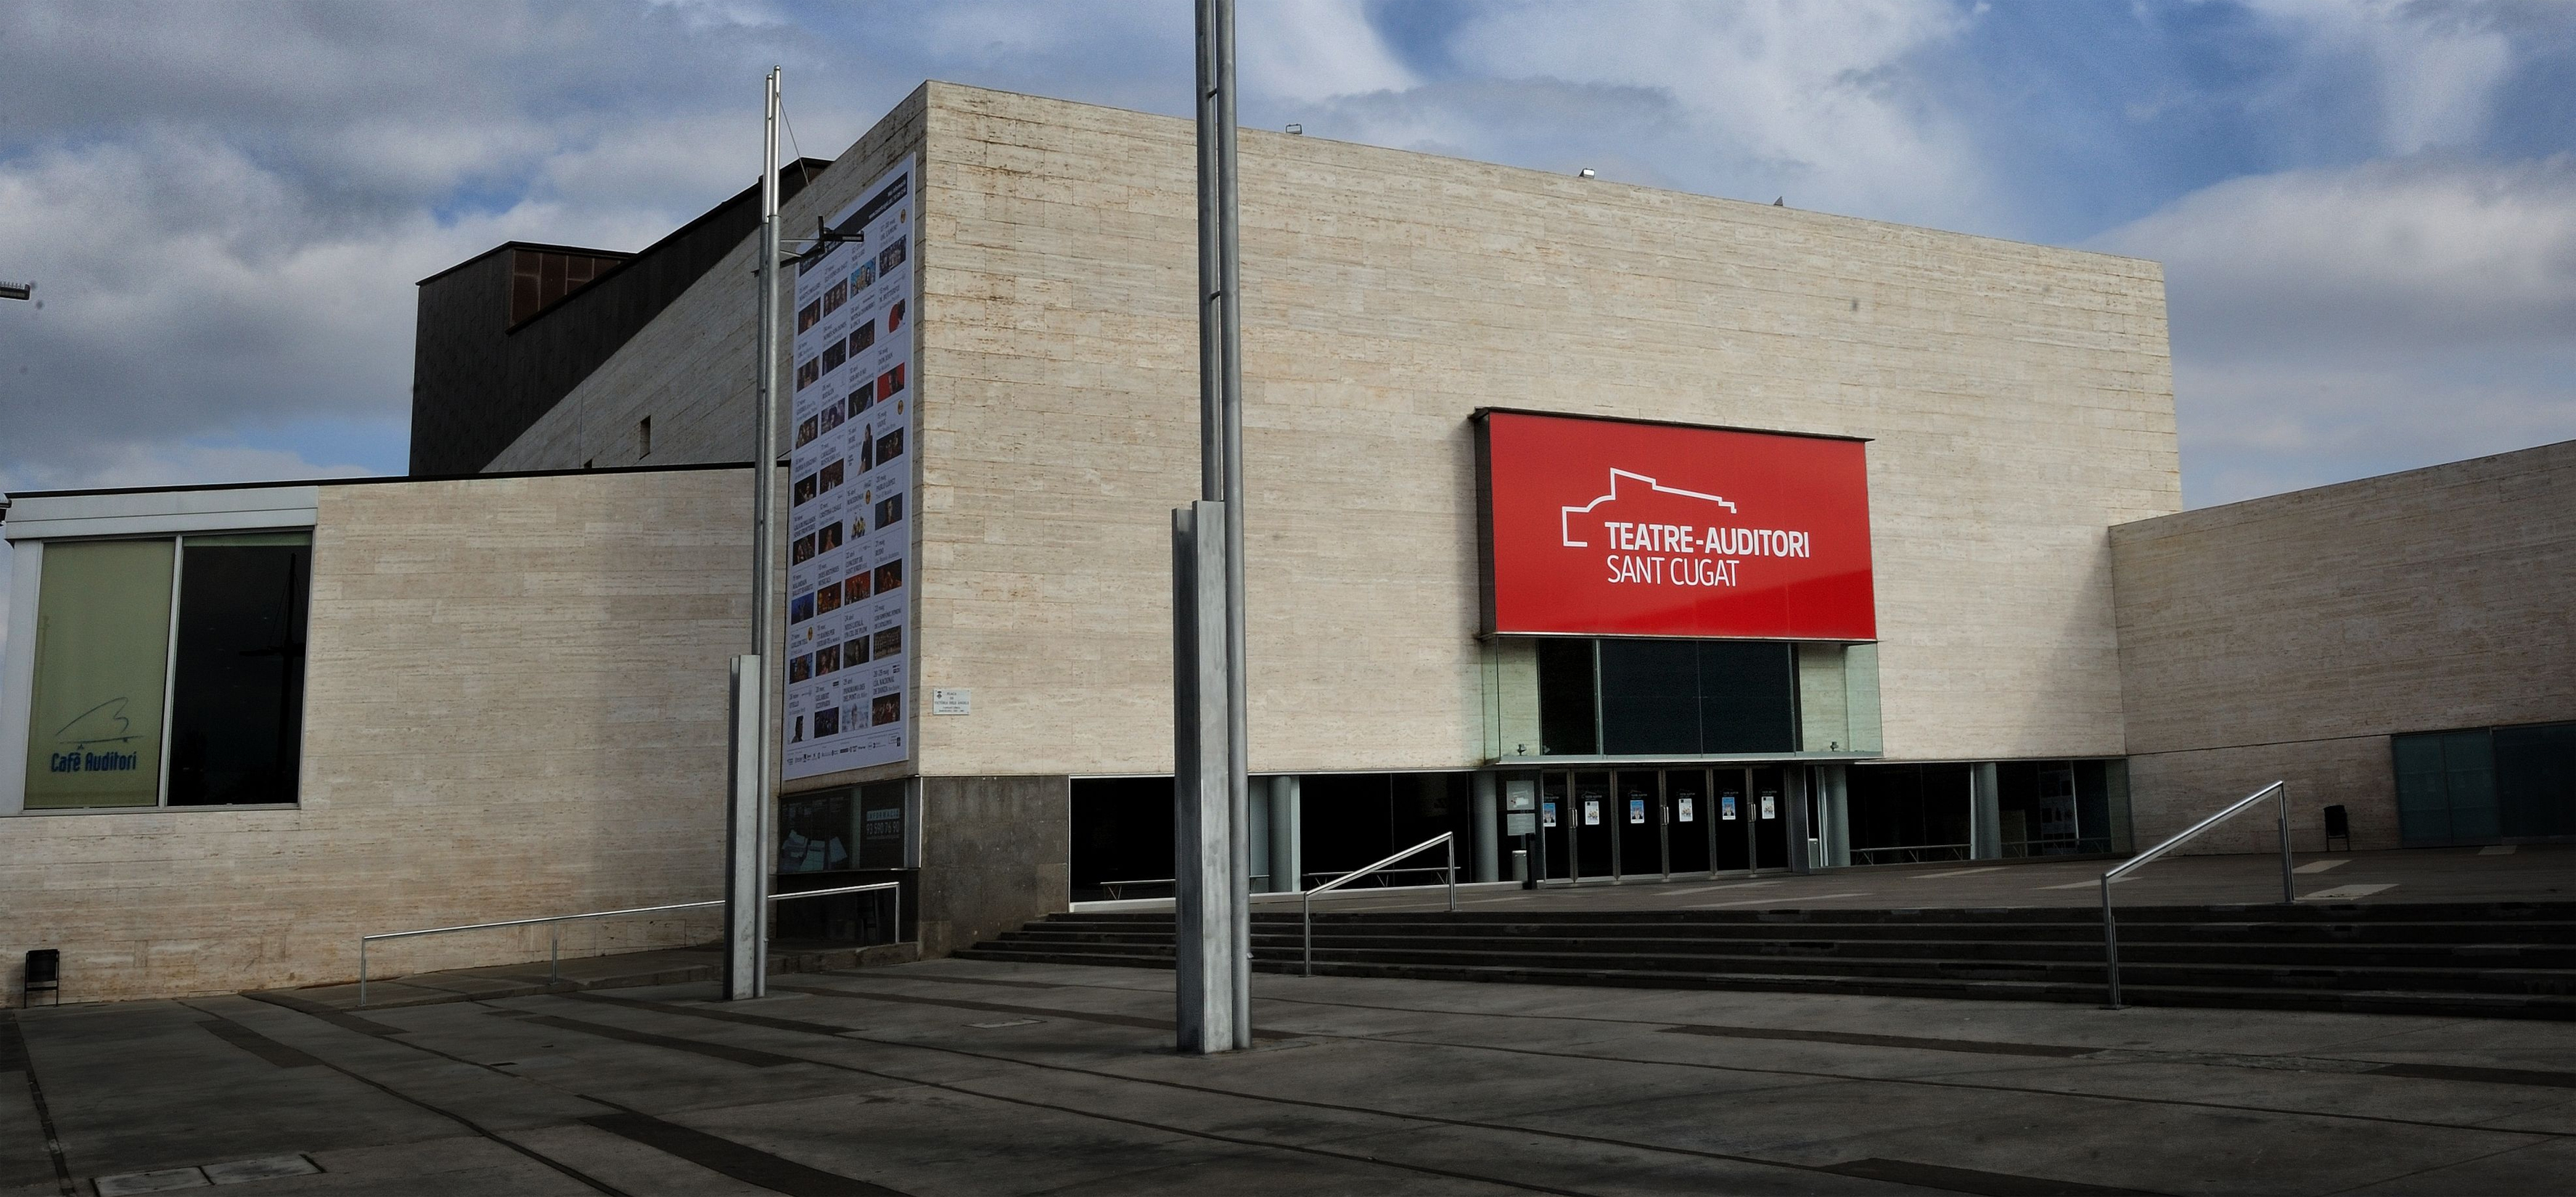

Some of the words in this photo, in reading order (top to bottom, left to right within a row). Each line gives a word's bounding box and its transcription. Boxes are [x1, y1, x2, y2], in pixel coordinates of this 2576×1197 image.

[1604, 522, 1810, 557] TEATRE-AUDITORI
[1607, 555, 1665, 584] SANT
[1670, 558, 1739, 587] CUGAT
[85, 751, 137, 772] Auditori
